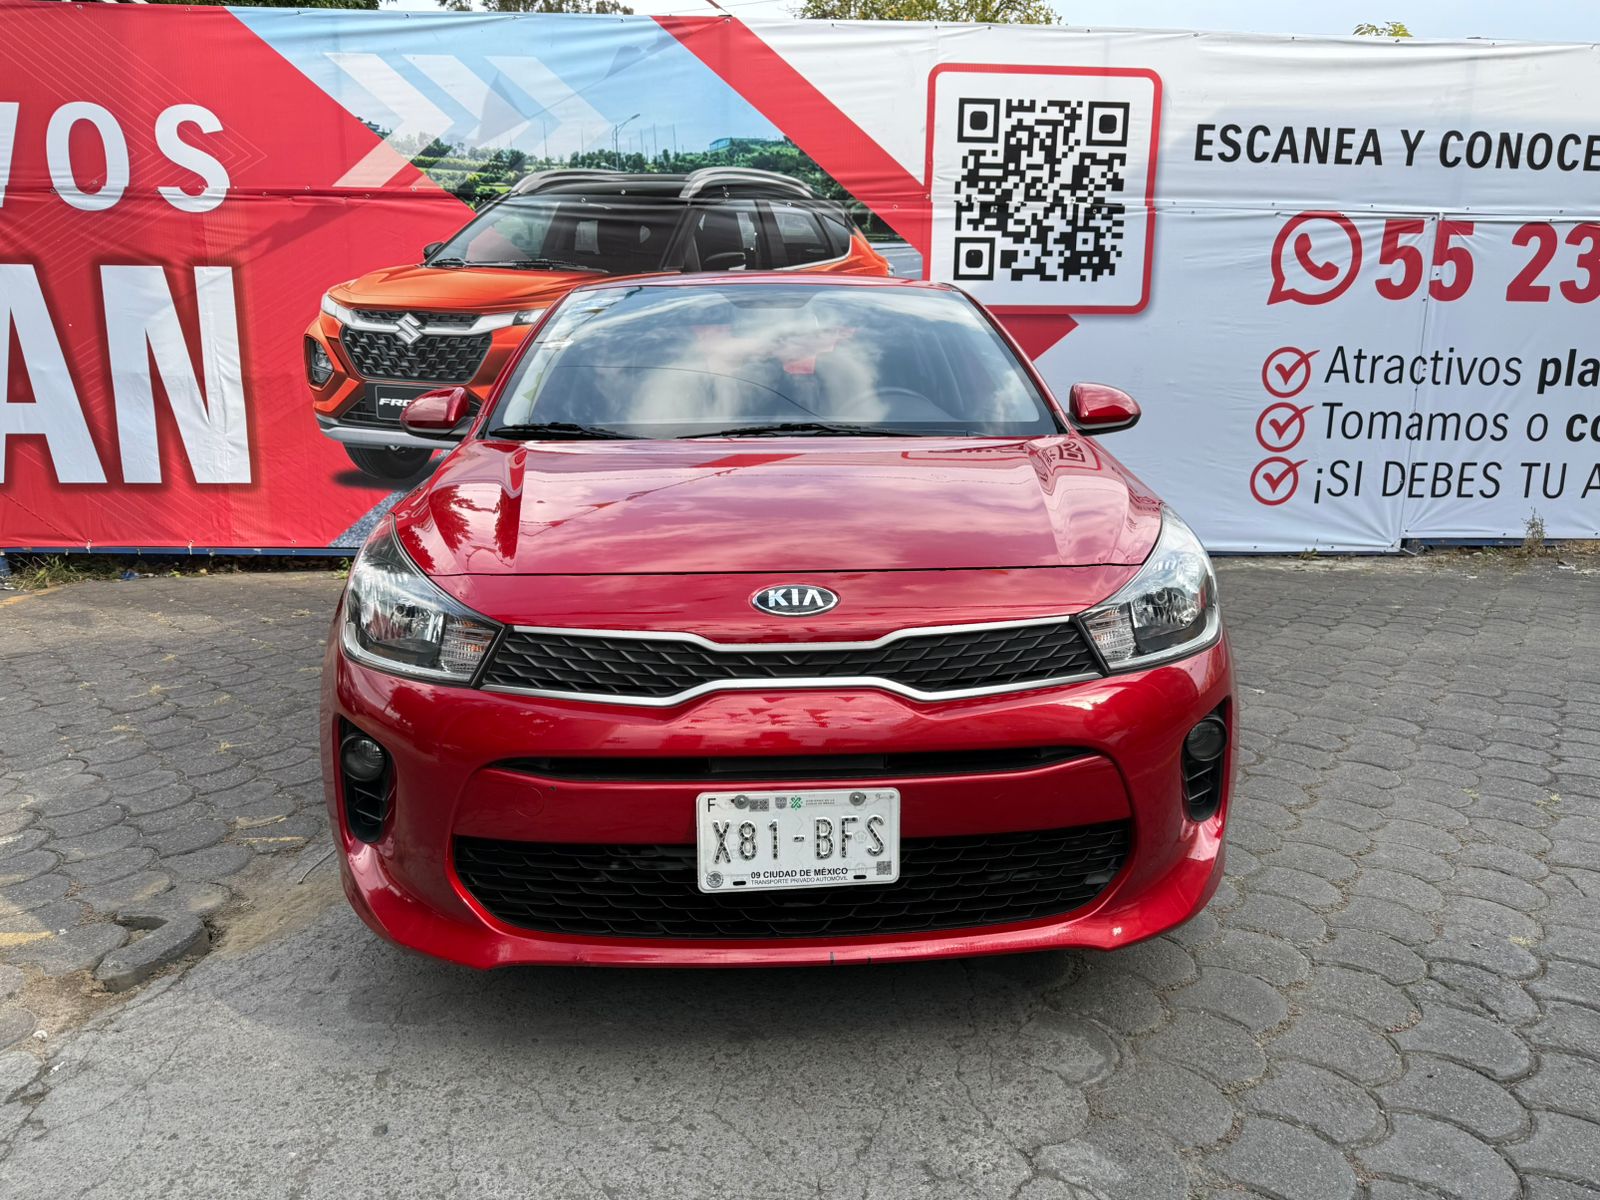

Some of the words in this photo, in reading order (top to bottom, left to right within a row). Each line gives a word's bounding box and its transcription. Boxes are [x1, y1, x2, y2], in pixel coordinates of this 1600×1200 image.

[1194, 124, 1384, 165] ESCANEA
[1400, 129, 1426, 166] Y
[1438, 130, 1600, 172] CONOCE
[1375, 218, 1475, 302] 55
[1505, 221, 1600, 304] 23
[1324, 345, 1523, 386] Atractivos
[1537, 348, 1600, 394] pla
[1321, 402, 1509, 442] Tomamos
[1526, 413, 1549, 442] o
[1313, 459, 1363, 504] ¡SI
[1382, 461, 1503, 498] DEBES
[1520, 462, 1567, 499] TU
[767, 588, 825, 608] KIA
[707, 797, 716, 812] F
[712, 815, 886, 864] X81-BFS
[750, 871, 761, 879] 09
[763, 870, 797, 878] CIUDAD
[799, 869, 811, 877] DE
[813, 867, 848, 876] MÉXICO
